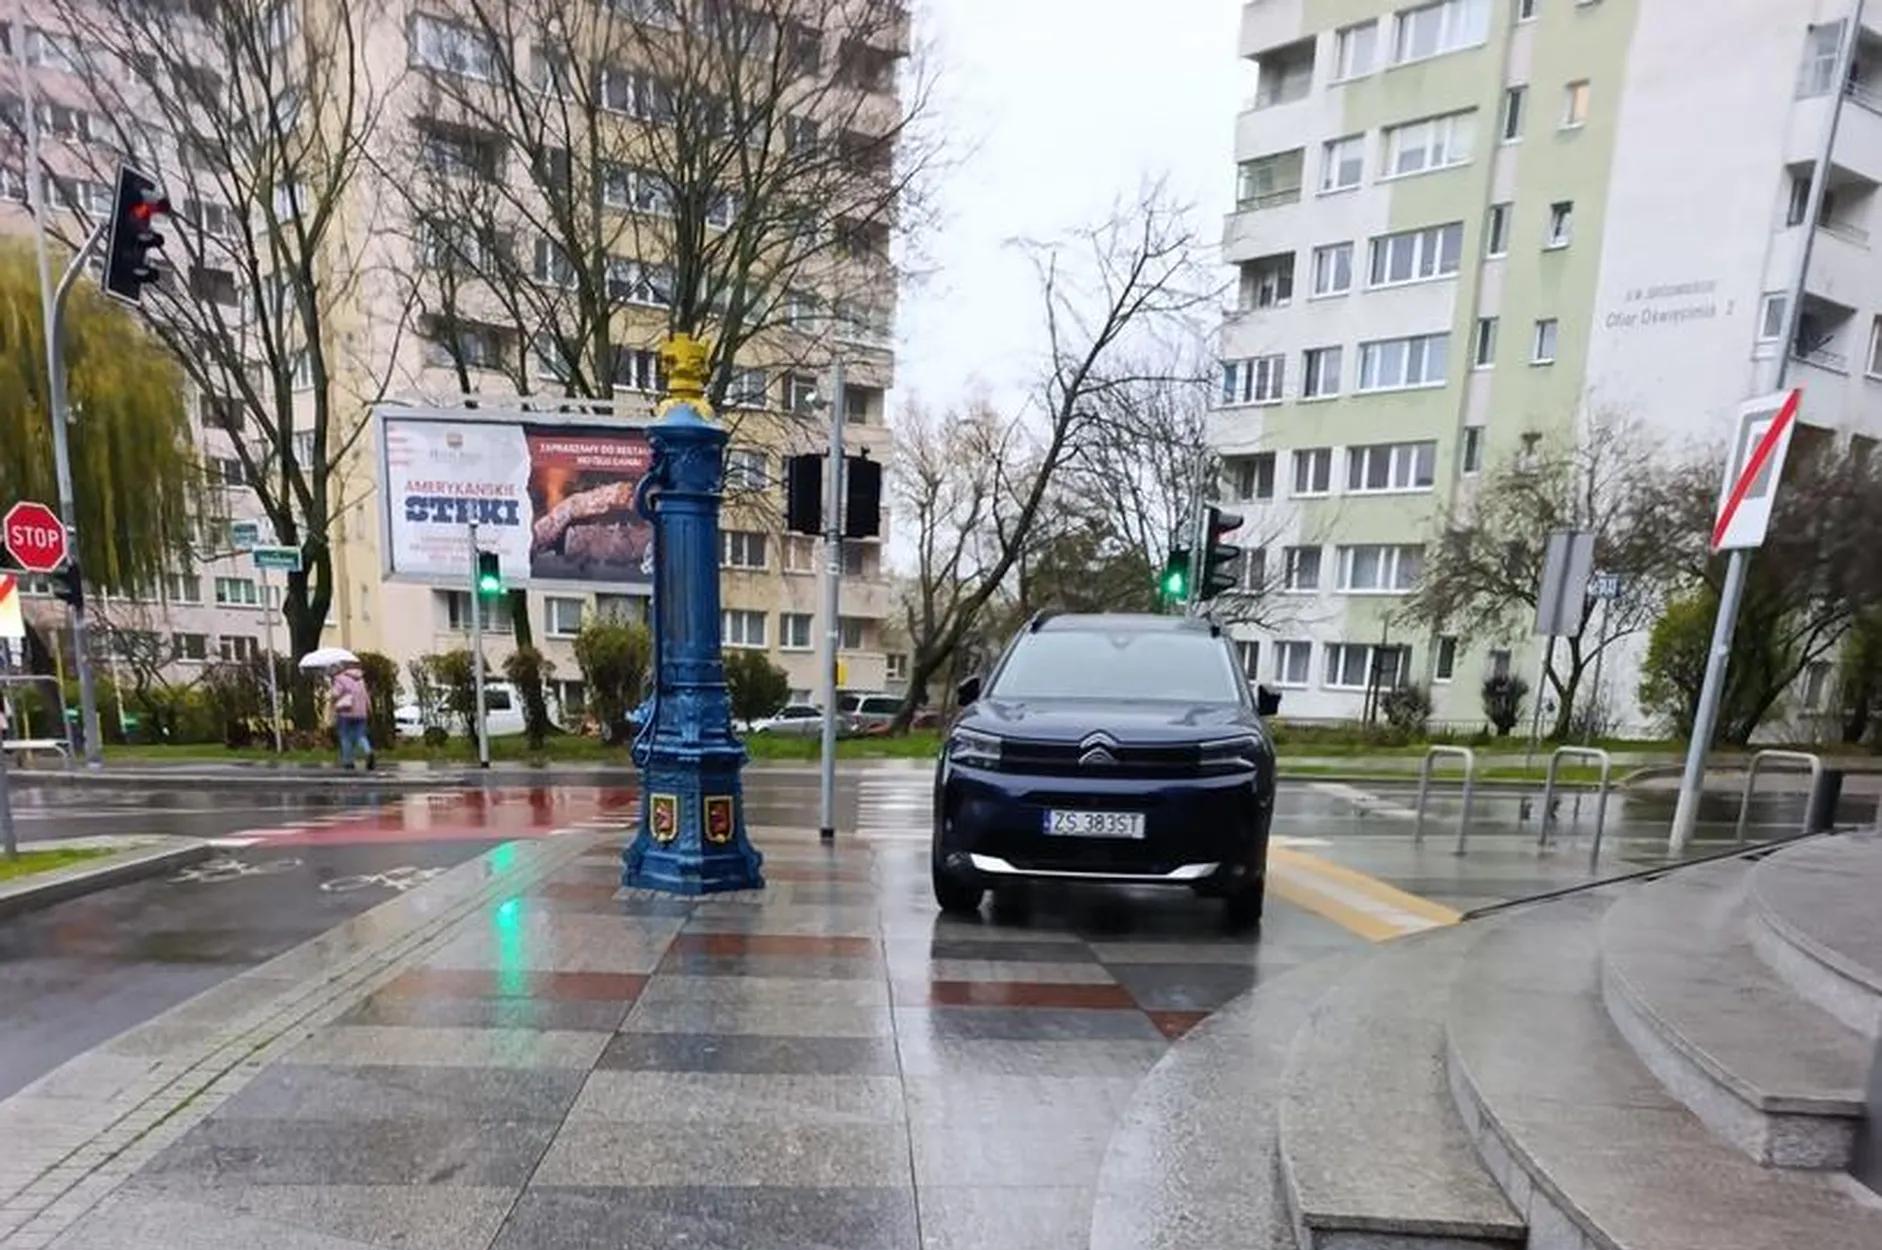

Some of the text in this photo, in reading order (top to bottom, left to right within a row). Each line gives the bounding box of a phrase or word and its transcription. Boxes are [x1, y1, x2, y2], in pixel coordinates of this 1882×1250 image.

[406, 480, 517, 497] AMERYKAŃSKIE
[405, 496, 520, 526] STEKI
[11, 525, 59, 549] STOP
[1054, 811, 1138, 833] ZS 383ST
